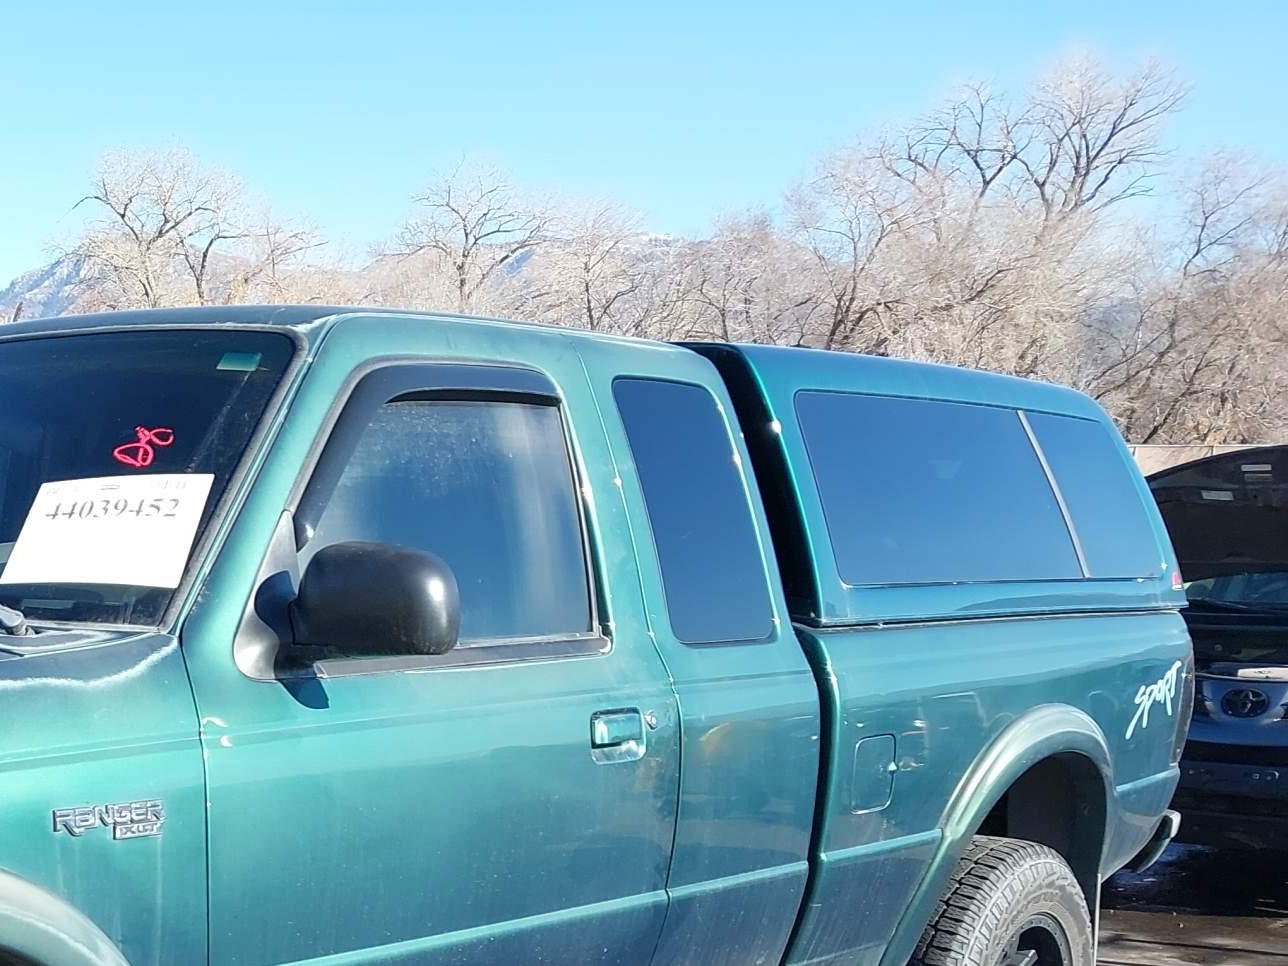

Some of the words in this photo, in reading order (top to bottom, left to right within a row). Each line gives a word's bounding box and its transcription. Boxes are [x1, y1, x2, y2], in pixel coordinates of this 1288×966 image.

[45, 498, 179, 520] 44039452
[1125, 660, 1182, 740] SPORT
[52, 799, 168, 837] RANGER
